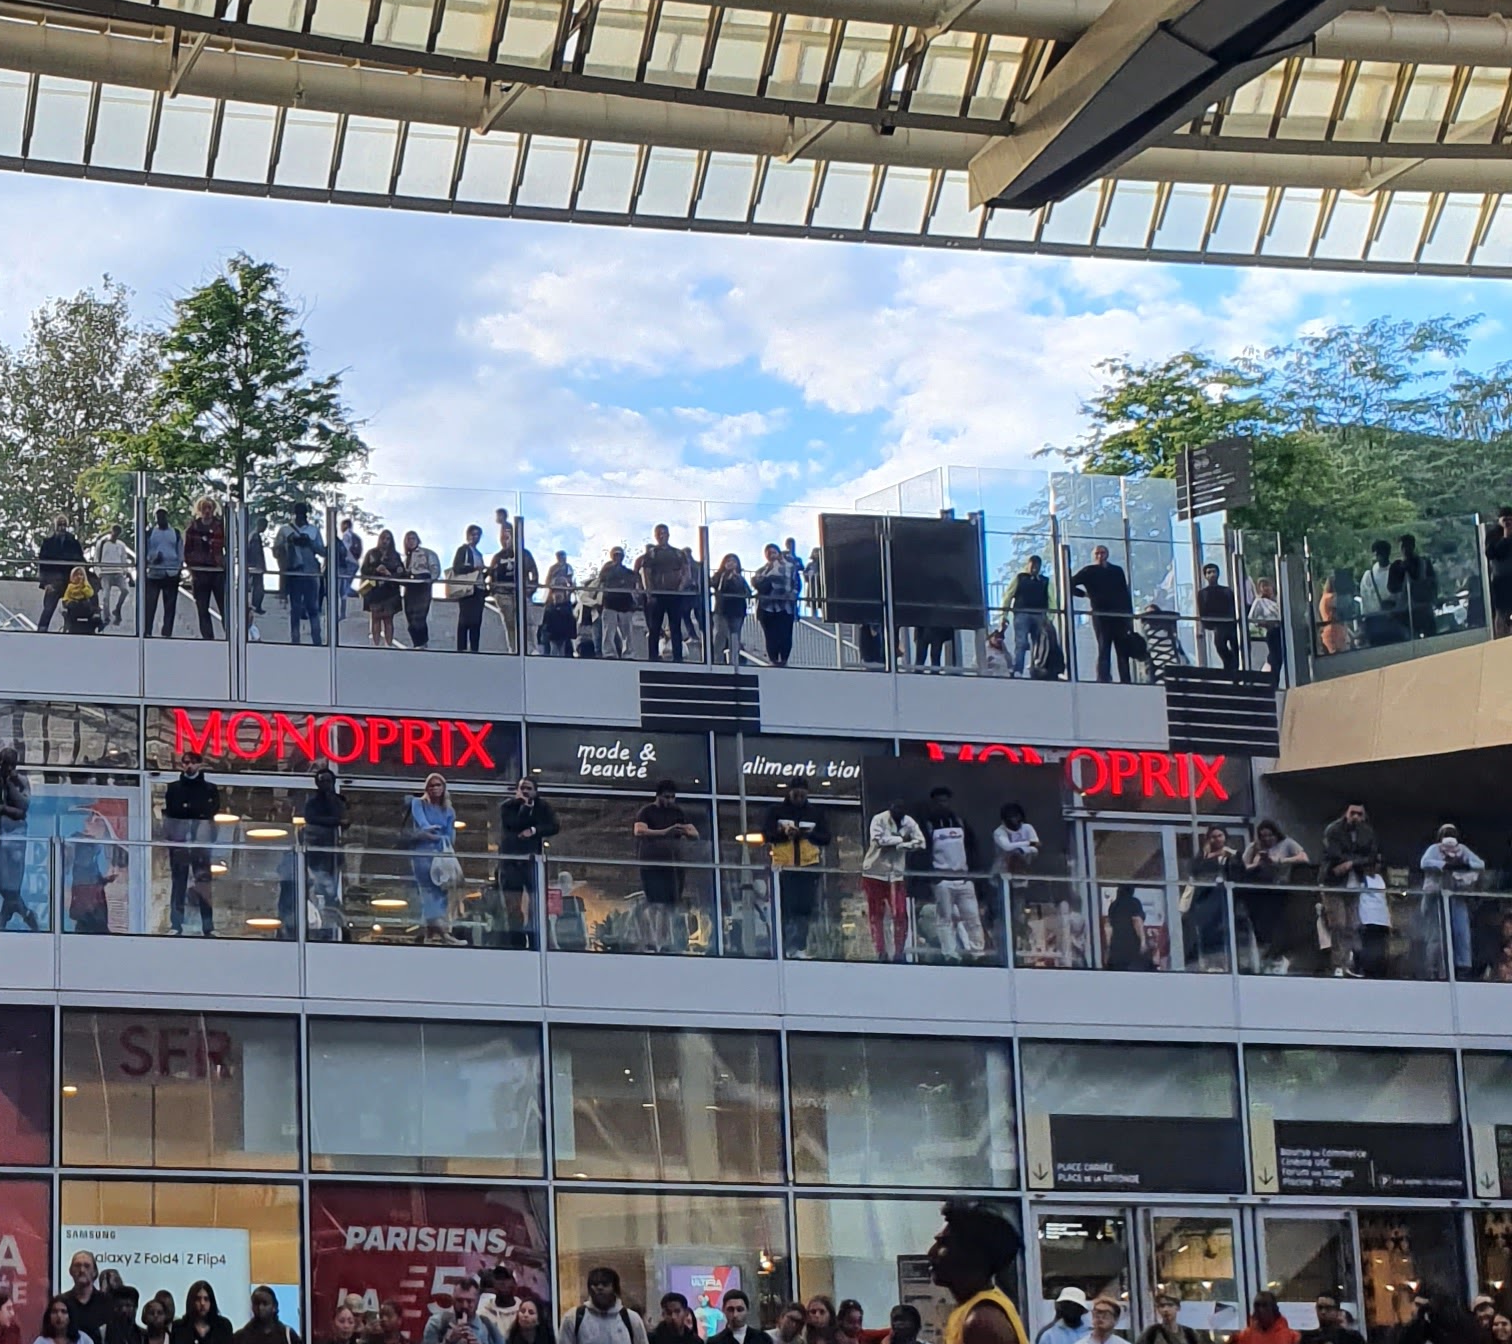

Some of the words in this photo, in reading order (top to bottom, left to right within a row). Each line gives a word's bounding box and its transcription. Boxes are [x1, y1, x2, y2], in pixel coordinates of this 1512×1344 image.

[173, 708, 496, 768] MONOPRIX
[577, 741, 630, 761] mode
[640, 743, 656, 762] &
[580, 760, 649, 779] beauté
[119, 1025, 232, 1078] SFR
[66, 1230, 116, 1239] SAMSUNG
[345, 1226, 515, 1257] PARISIENS,
[94, 1252, 132, 1267] alaxy
[134, 1253, 141, 1264] Z
[144, 1252, 179, 1264] Fold4
[187, 1254, 194, 1264] Z
[197, 1254, 227, 1268] Flip4
